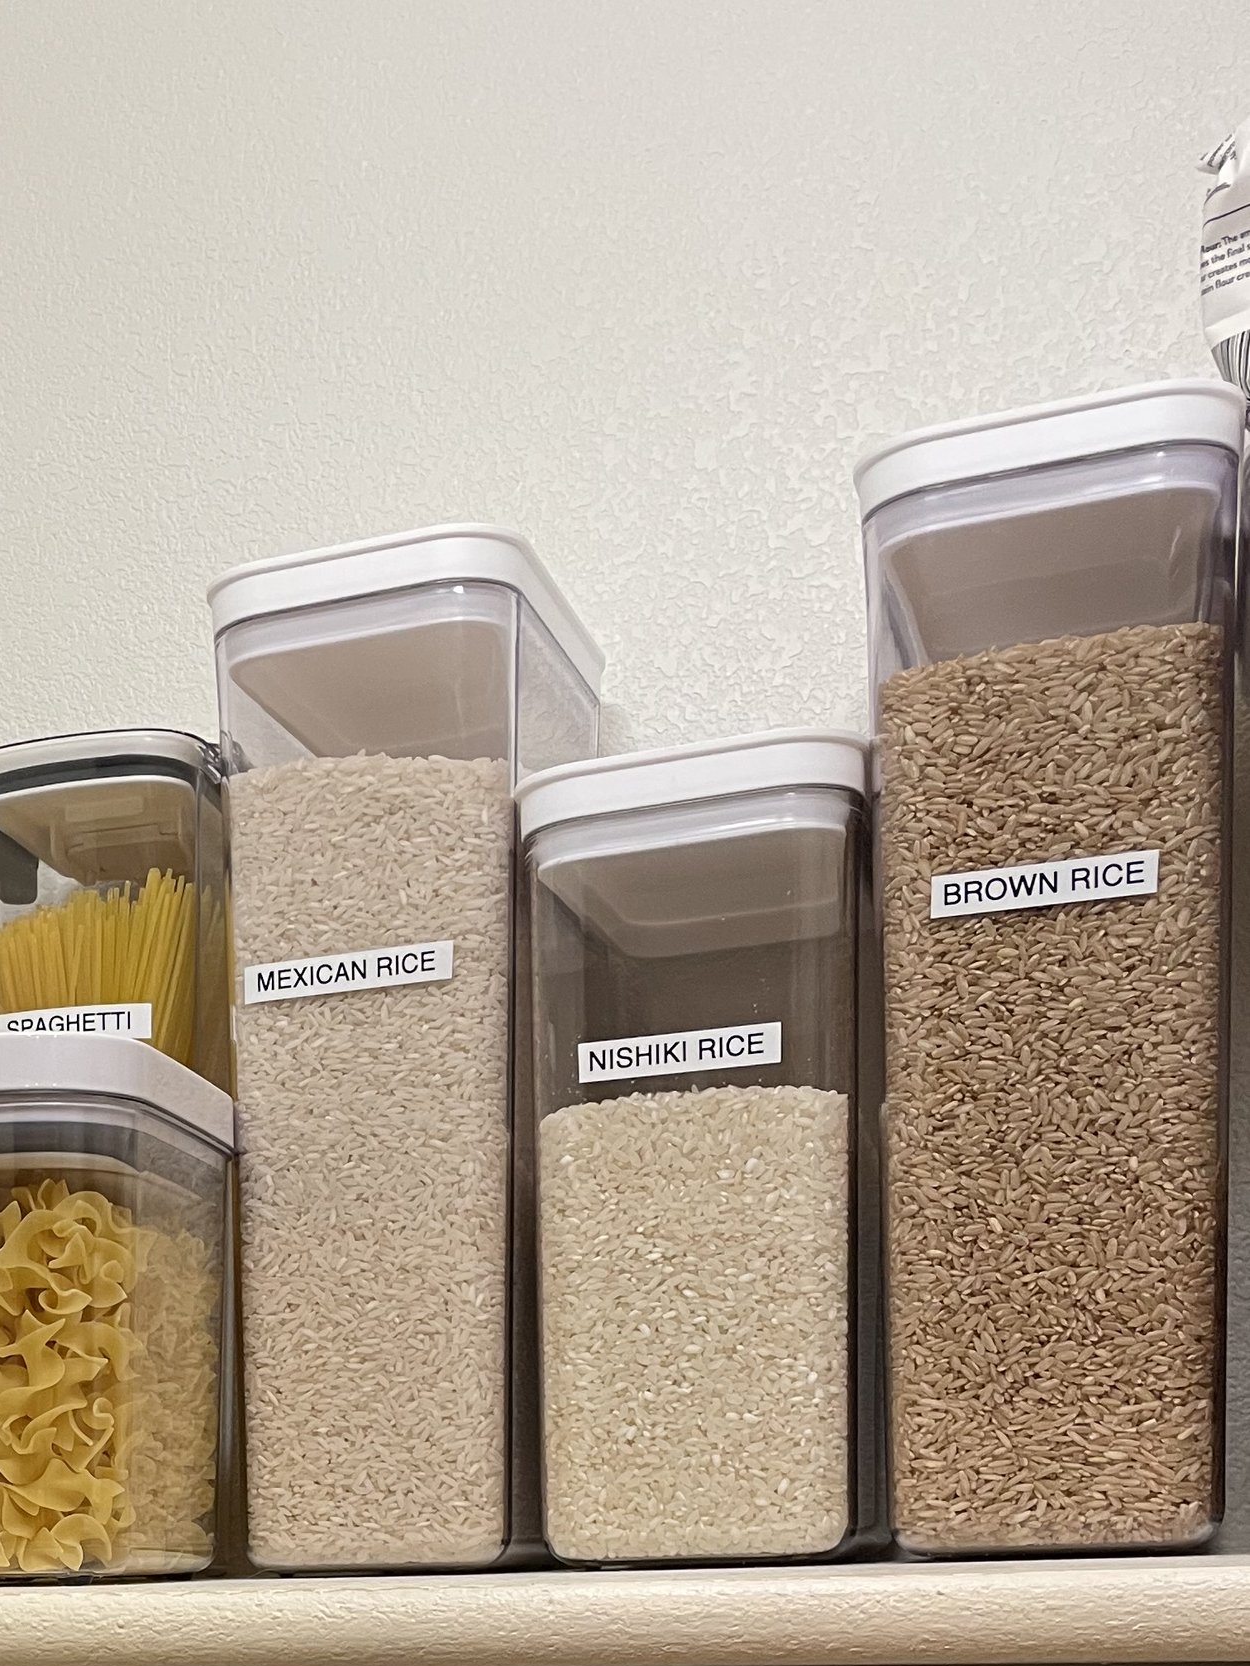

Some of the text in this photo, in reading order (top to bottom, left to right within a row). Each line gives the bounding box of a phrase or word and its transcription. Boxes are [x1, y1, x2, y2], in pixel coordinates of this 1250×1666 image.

[1221, 236, 1238, 245] The
[1211, 254, 1225, 264] the
[1208, 263, 1237, 278] creates
[944, 860, 1144, 906] BROWN RICE
[257, 950, 436, 992] MEXICAN RICE
[7, 1011, 131, 1032] SPAGHETTI
[589, 1032, 764, 1072] NISHIKI RICE
